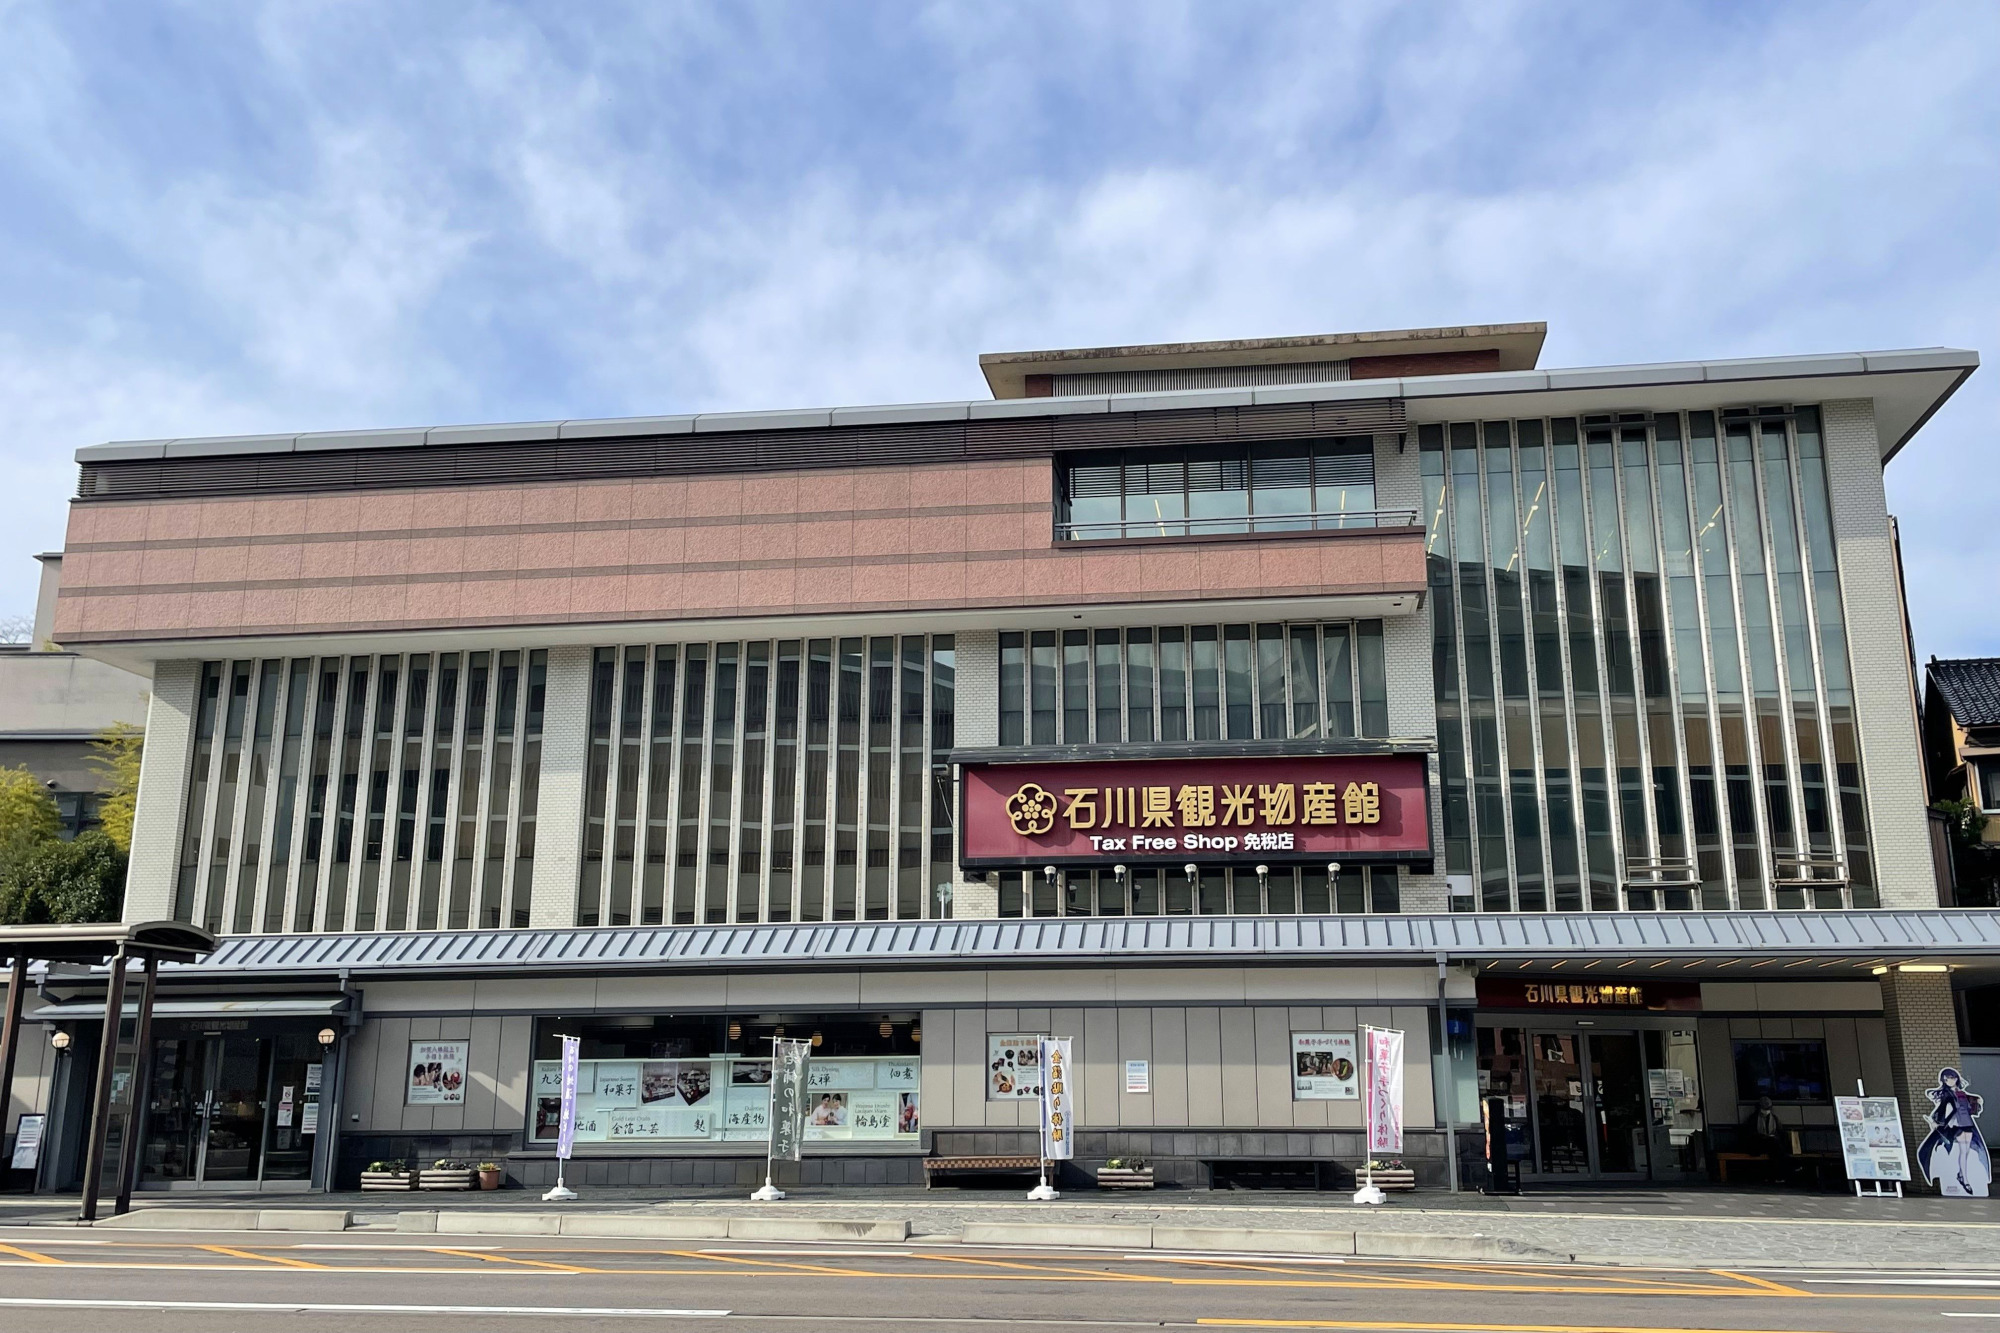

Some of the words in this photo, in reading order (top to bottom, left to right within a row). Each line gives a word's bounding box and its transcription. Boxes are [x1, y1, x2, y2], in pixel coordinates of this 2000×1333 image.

[1063, 781, 1380, 829] 石川県観光物産館
[1090, 835, 1126, 851] Tax
[1132, 834, 1177, 850] Free
[1183, 833, 1238, 853] Shop
[1244, 832, 1294, 851] 免税店
[1524, 984, 1643, 1004] 石川県観光物産館
[603, 1084, 635, 1096] 和菓子
[728, 1113, 765, 1125] 海産物
[855, 1114, 891, 1129] 輪島塗
[612, 1122, 659, 1134] 金箔工芸
